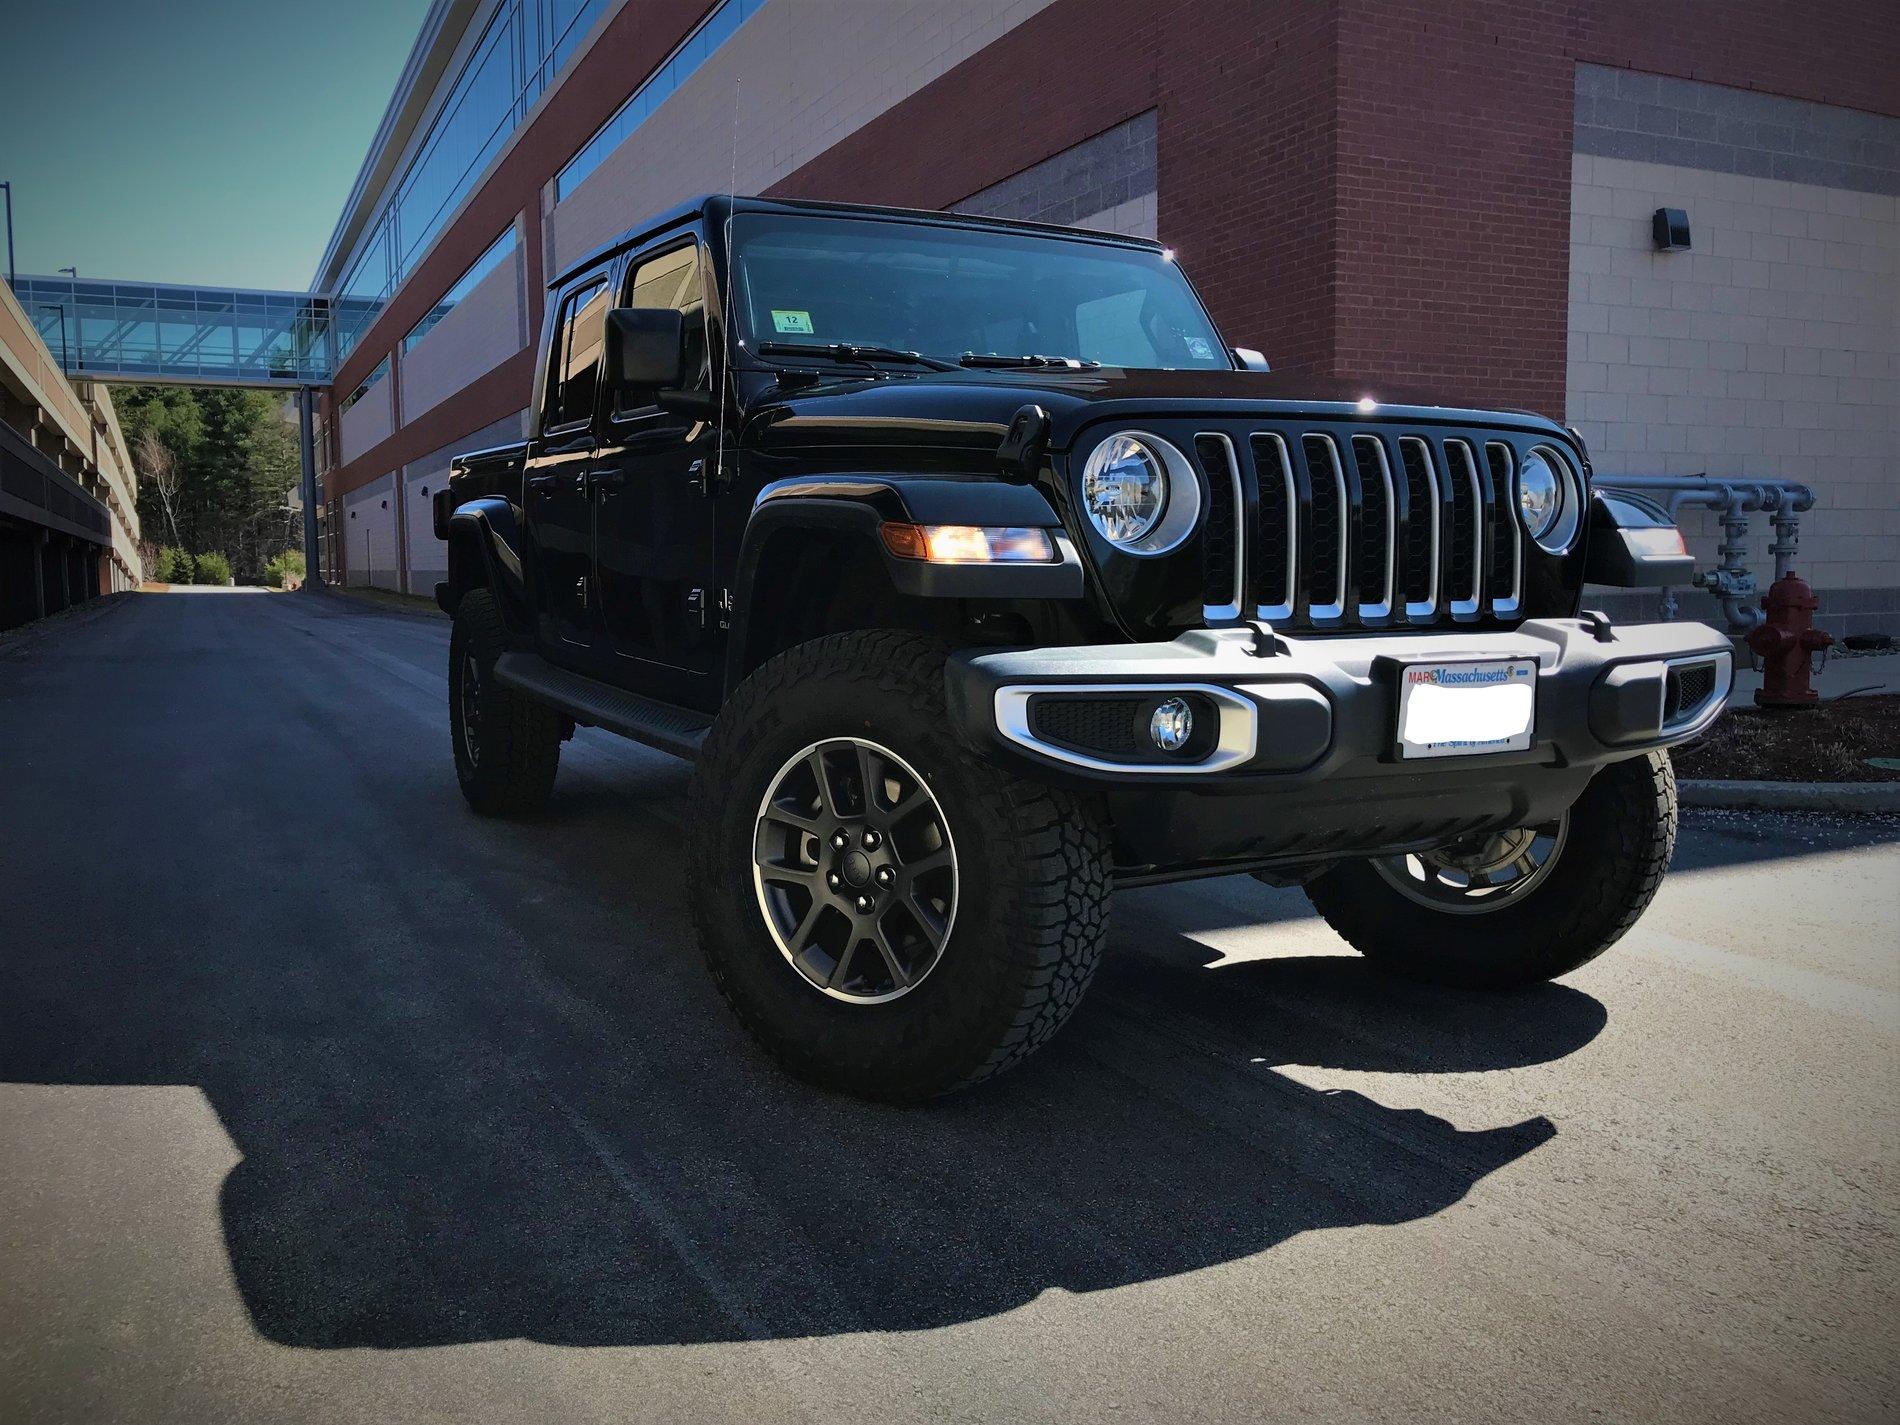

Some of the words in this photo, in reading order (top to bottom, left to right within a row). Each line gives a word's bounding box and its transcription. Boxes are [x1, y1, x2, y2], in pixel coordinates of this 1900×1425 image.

[786, 316, 798, 324] 12
[1408, 672, 1430, 684] MAR
[1435, 668, 1508, 684] Massachusetts
